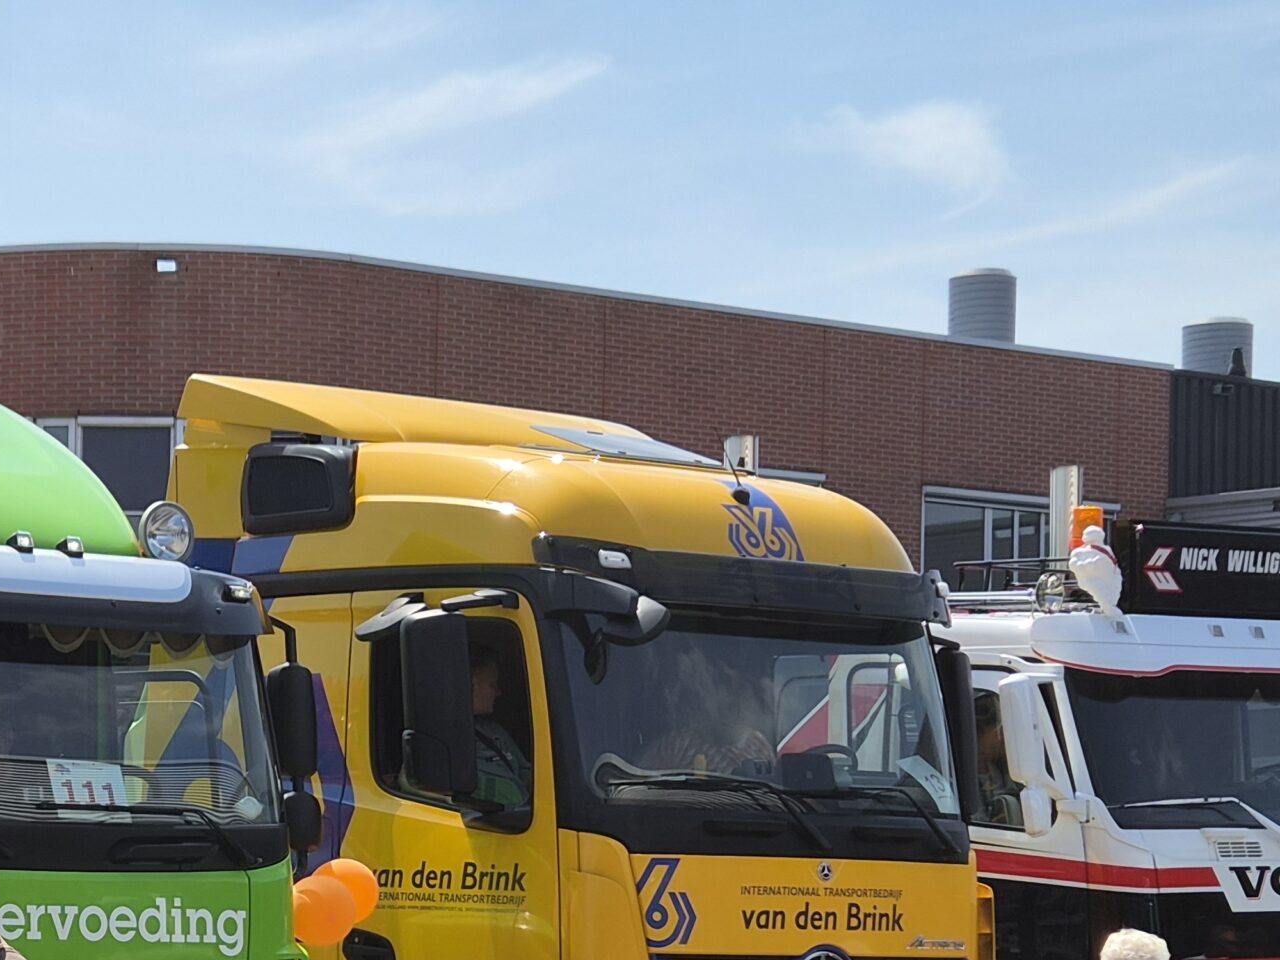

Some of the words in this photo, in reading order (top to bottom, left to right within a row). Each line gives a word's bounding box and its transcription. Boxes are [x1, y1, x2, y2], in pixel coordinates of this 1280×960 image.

[1179, 546, 1220, 572] NICK
[1227, 549, 1280, 575] WILLIG
[61, 779, 117, 807] 111
[372, 868, 404, 889] an
[411, 860, 453, 890] den
[460, 861, 527, 892] Brink
[378, 891, 437, 903] ERNATIONAAL
[439, 892, 527, 908] TRANSPORTBEDRIJF
[740, 885, 821, 898] INTERNATIONAAL
[823, 887, 903, 901] TRANSPORTBEDRIJF
[741, 909, 787, 931] van
[795, 901, 838, 931] den
[846, 902, 905, 932] Brink
